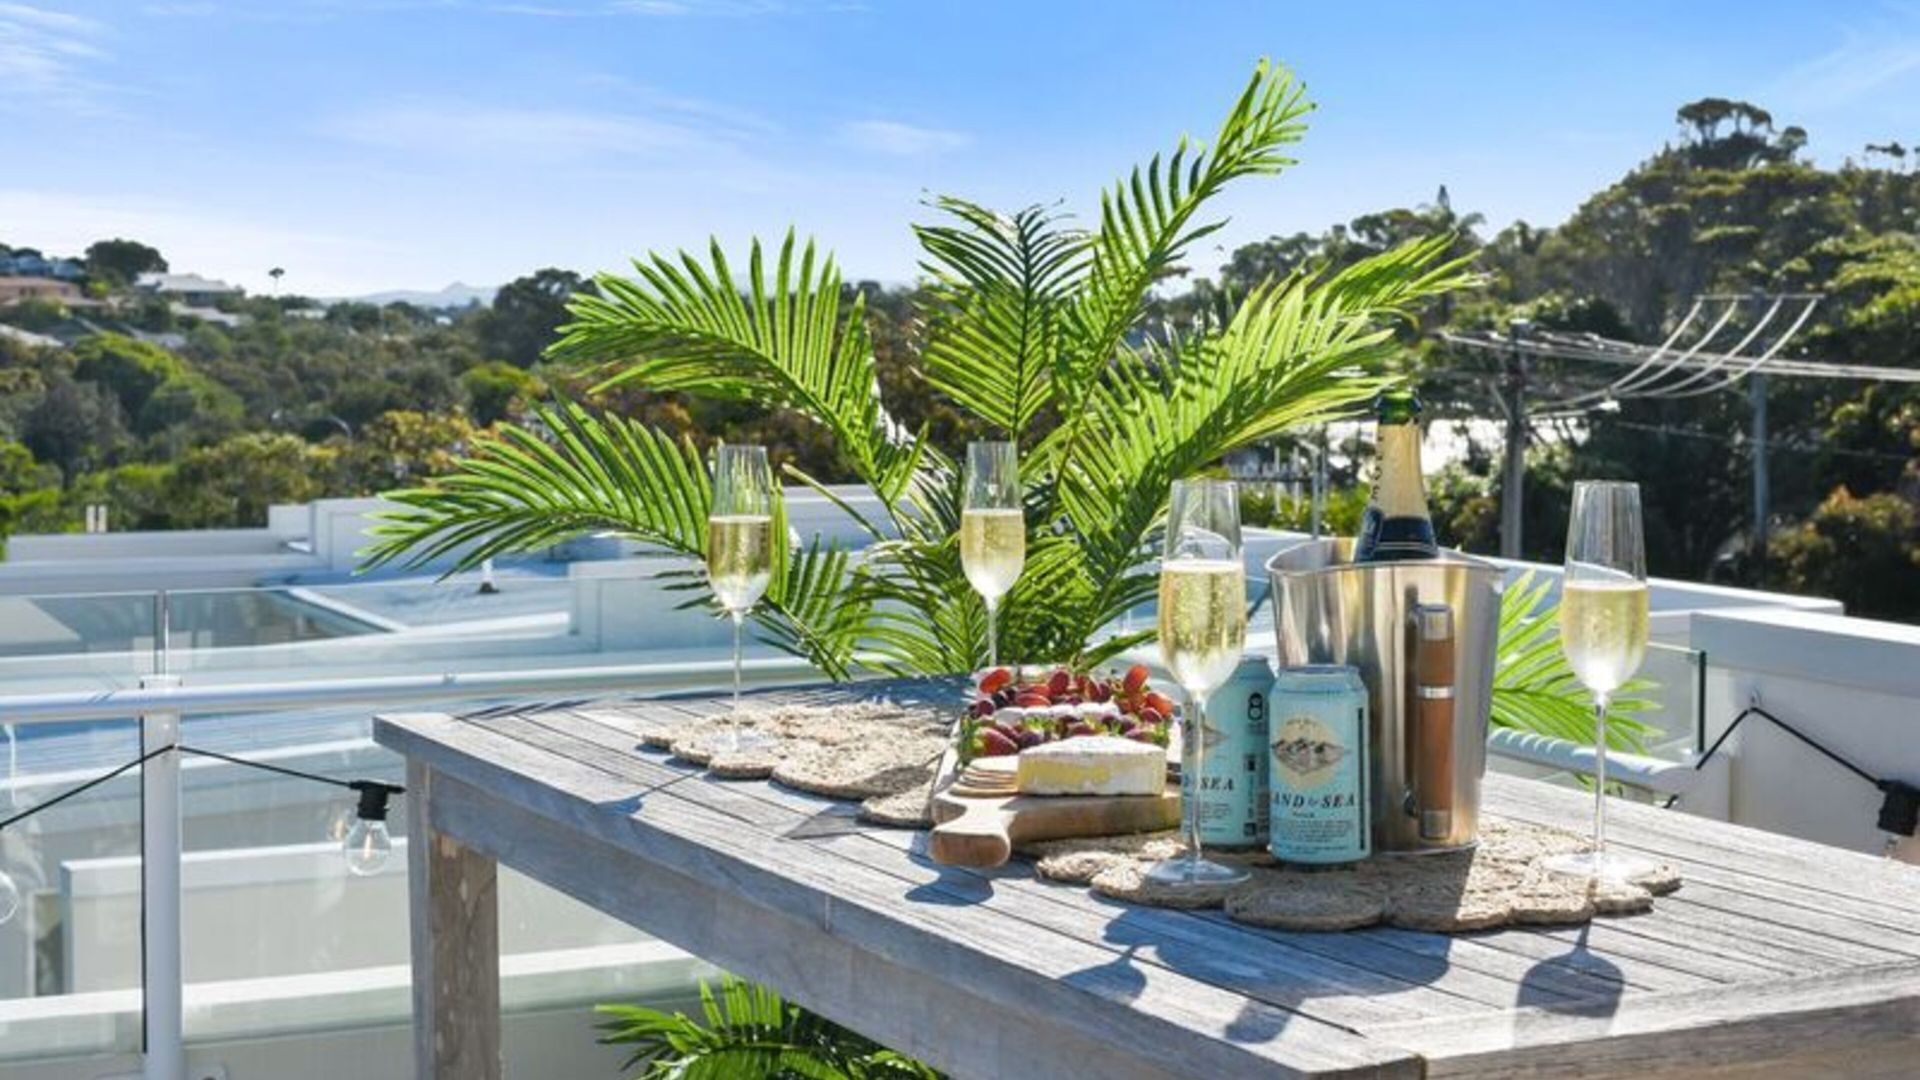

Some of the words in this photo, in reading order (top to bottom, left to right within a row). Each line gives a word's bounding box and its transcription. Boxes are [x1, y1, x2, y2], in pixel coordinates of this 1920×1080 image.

[1200, 777, 1234, 791] SEA
[1272, 792, 1305, 808] AND
[1321, 793, 1356, 808] SEA
